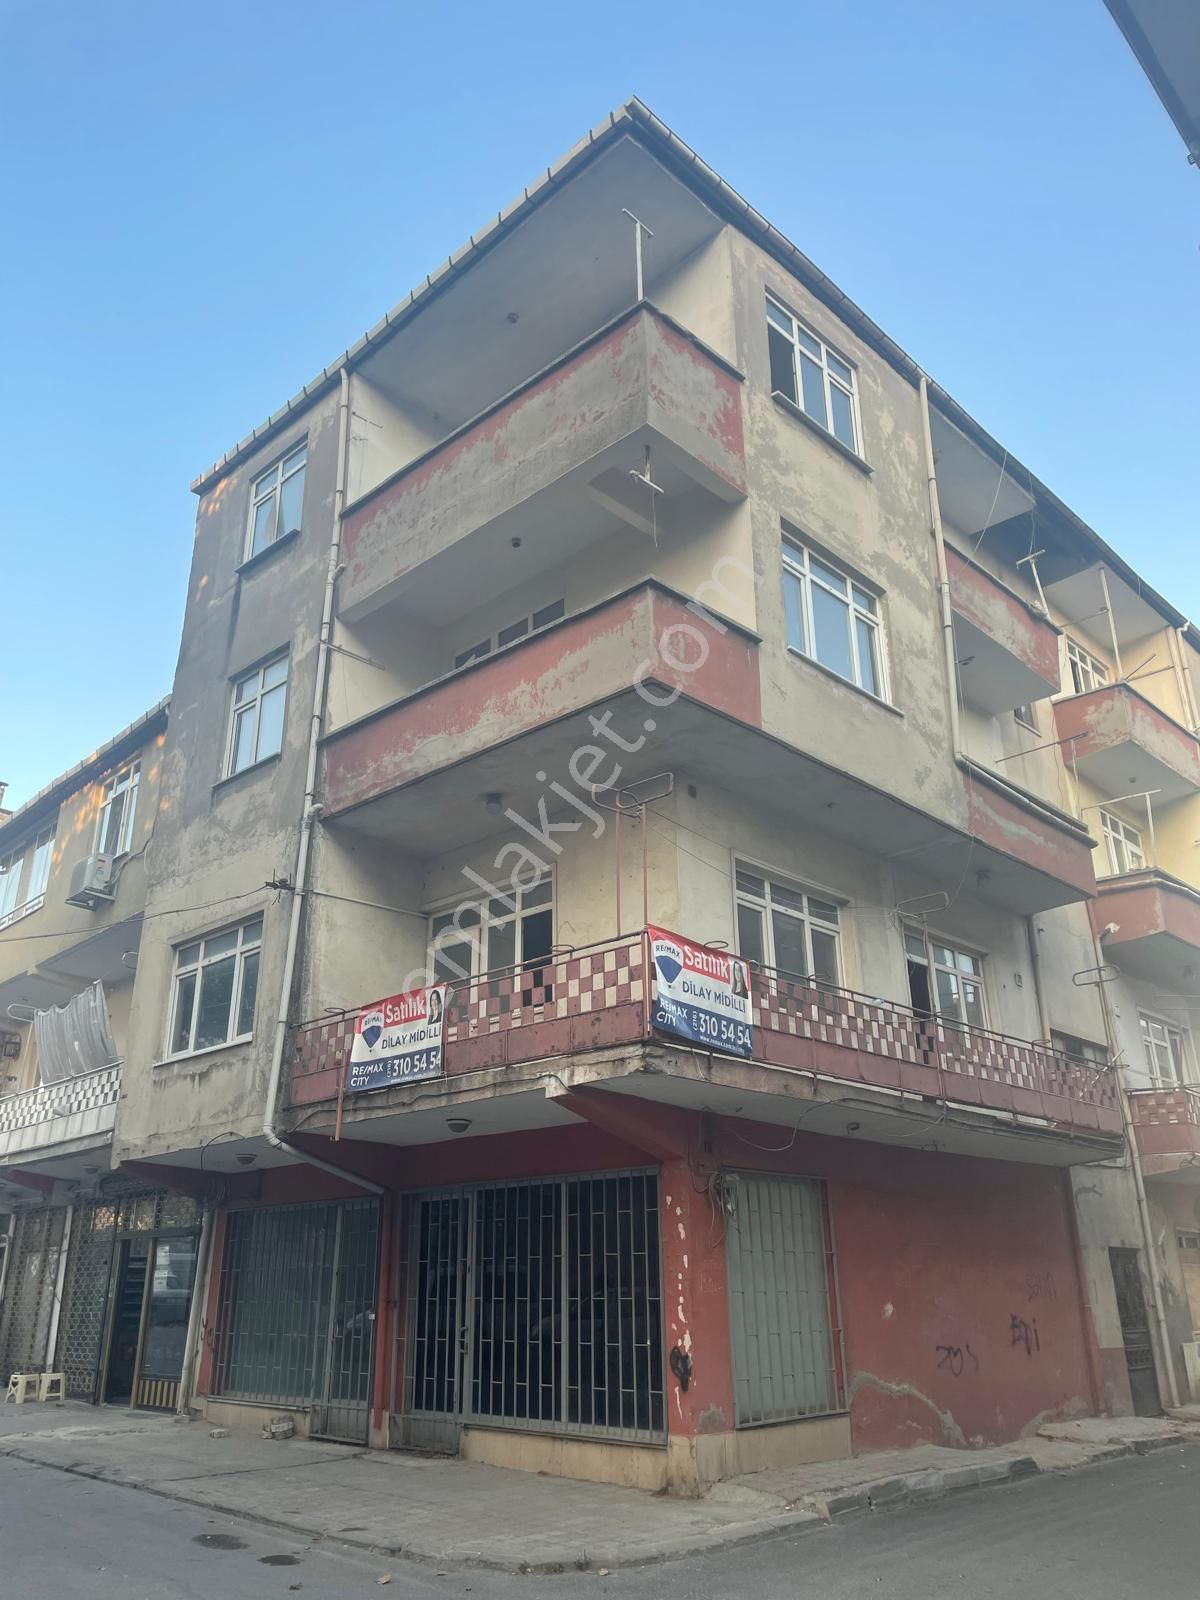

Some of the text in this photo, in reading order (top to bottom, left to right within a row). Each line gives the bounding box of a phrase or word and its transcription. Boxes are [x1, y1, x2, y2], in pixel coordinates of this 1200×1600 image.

[655, 944, 681, 957] RE/MAX
[682, 981, 712, 1001] DİLAY
[386, 996, 426, 1023] Satılık
[660, 998, 688, 1019] RE/MAX
[656, 1011, 677, 1027] CITY
[699, 1013, 718, 1036] 310
[721, 1021, 735, 1042] 54
[737, 1026, 752, 1050] 54
[381, 1033, 407, 1049] DİLAY
[352, 1062, 384, 1076] RE/MAX
[392, 1056, 411, 1077] 310
[413, 1052, 427, 1073] 54
[350, 1076, 370, 1087] CITY
